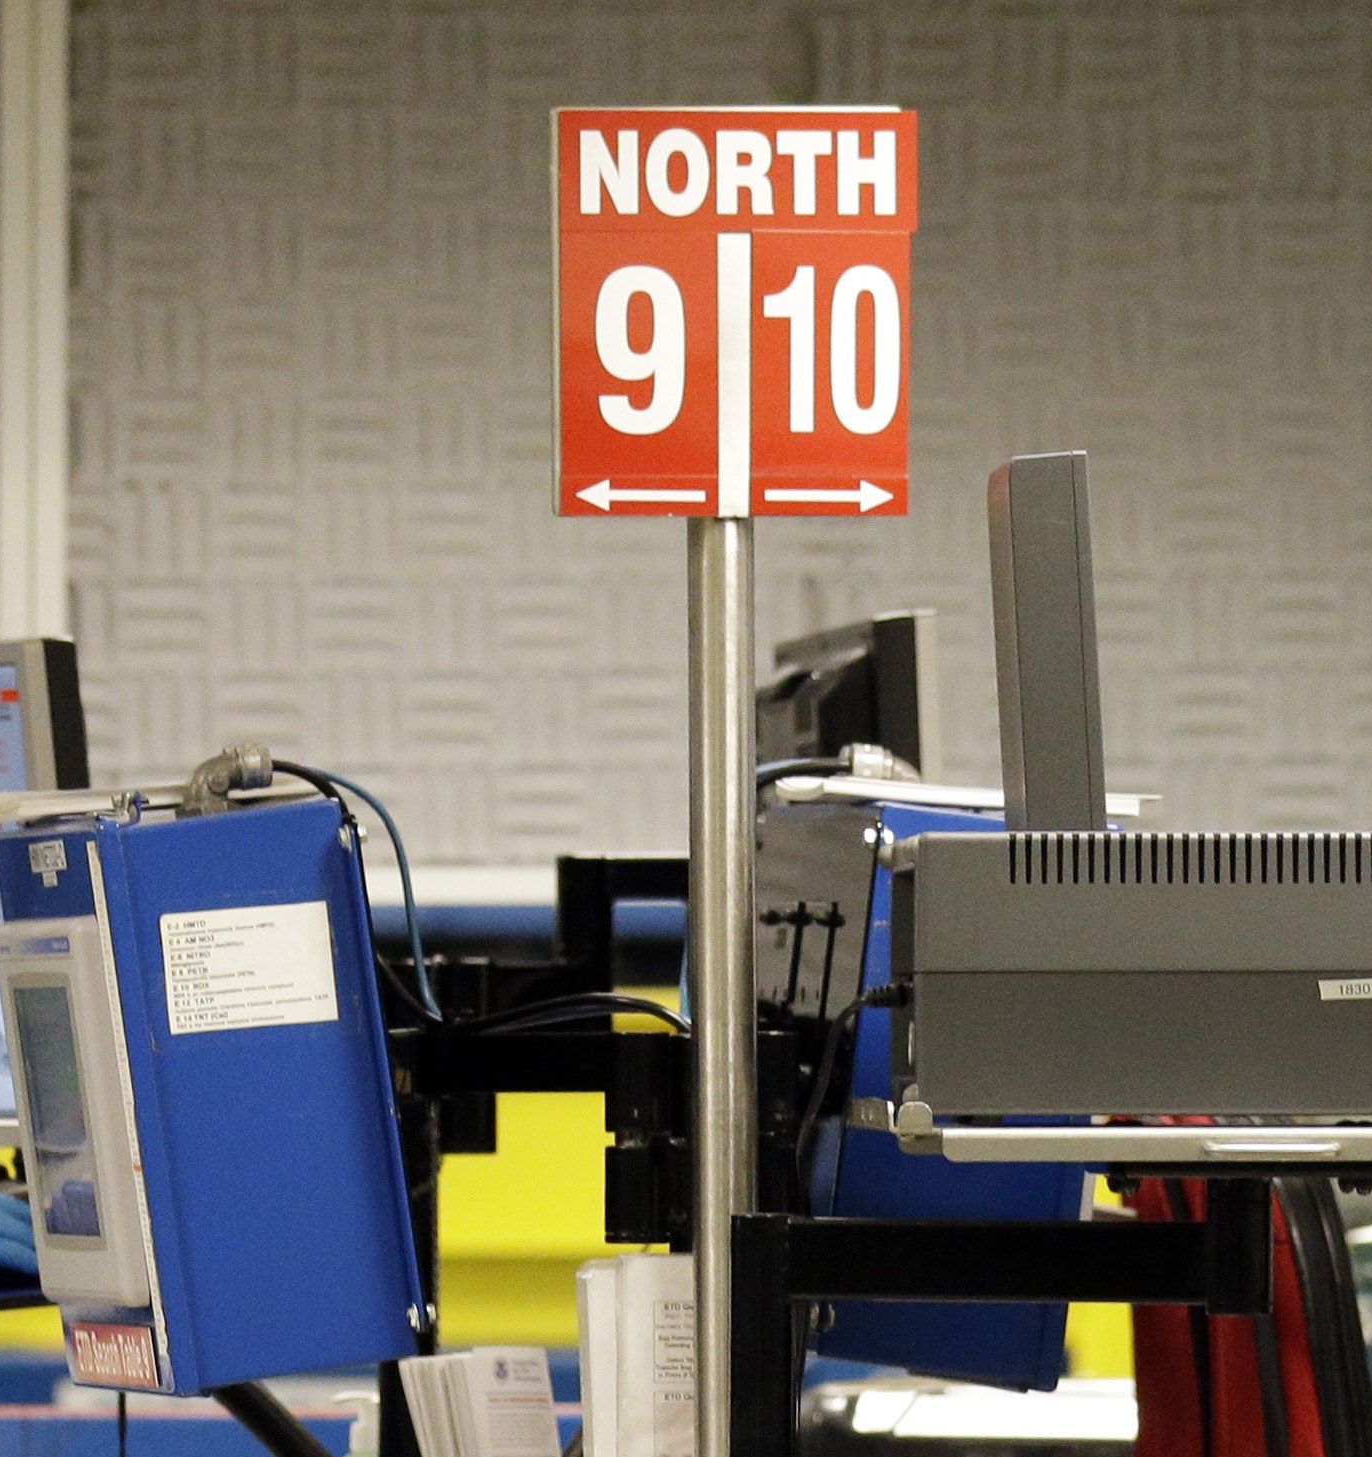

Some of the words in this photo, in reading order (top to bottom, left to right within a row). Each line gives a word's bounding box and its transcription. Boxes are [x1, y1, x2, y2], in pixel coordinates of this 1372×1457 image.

[579, 128, 897, 217] NORTH
[595, 265, 686, 435] 9
[763, 265, 901, 435] 10
